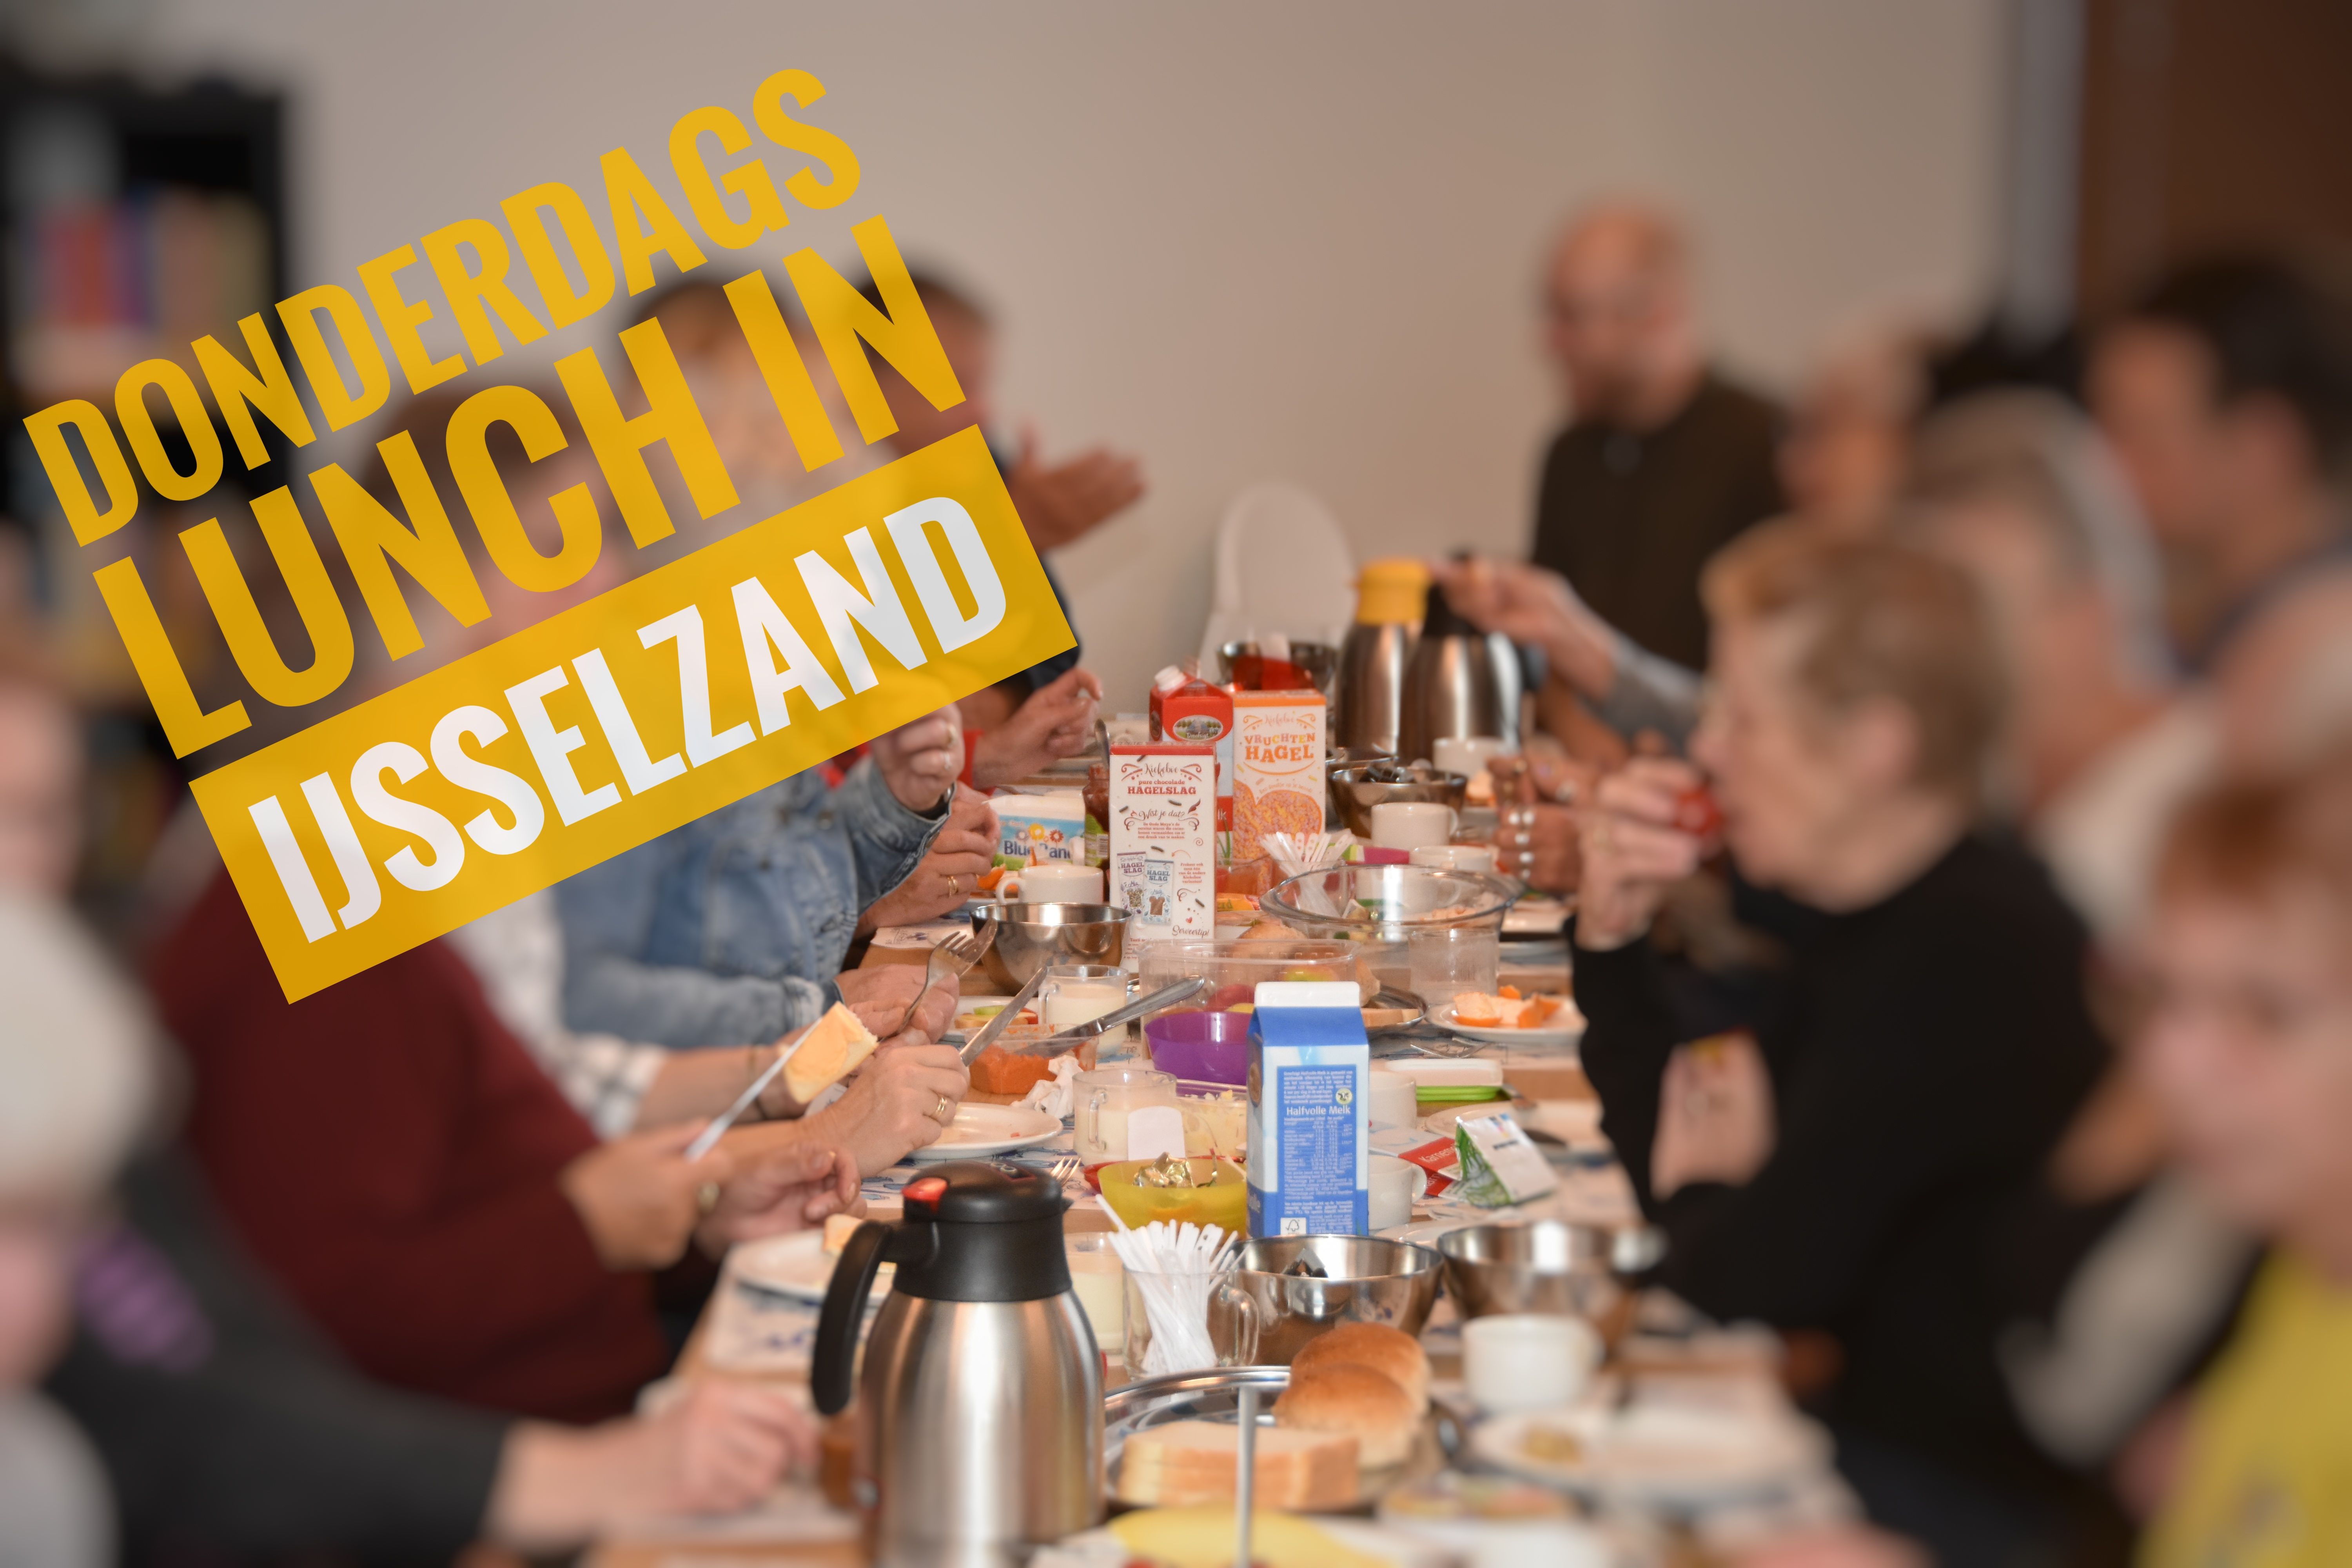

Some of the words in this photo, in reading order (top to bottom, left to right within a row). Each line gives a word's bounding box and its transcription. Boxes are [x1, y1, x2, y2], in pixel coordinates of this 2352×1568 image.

[1244, 733, 1315, 746] VRUCHTEN
[1245, 745, 1314, 764] HAGEL
[1145, 762, 1178, 777] Kiekeboe
[1127, 786, 1196, 795] HAGELSLAG
[1138, 809, 1158, 820] Wist
[1158, 810, 1166, 820] je
[1287, 1106, 1327, 1115] Halfvolle
[1329, 1105, 1351, 1114] Melk
